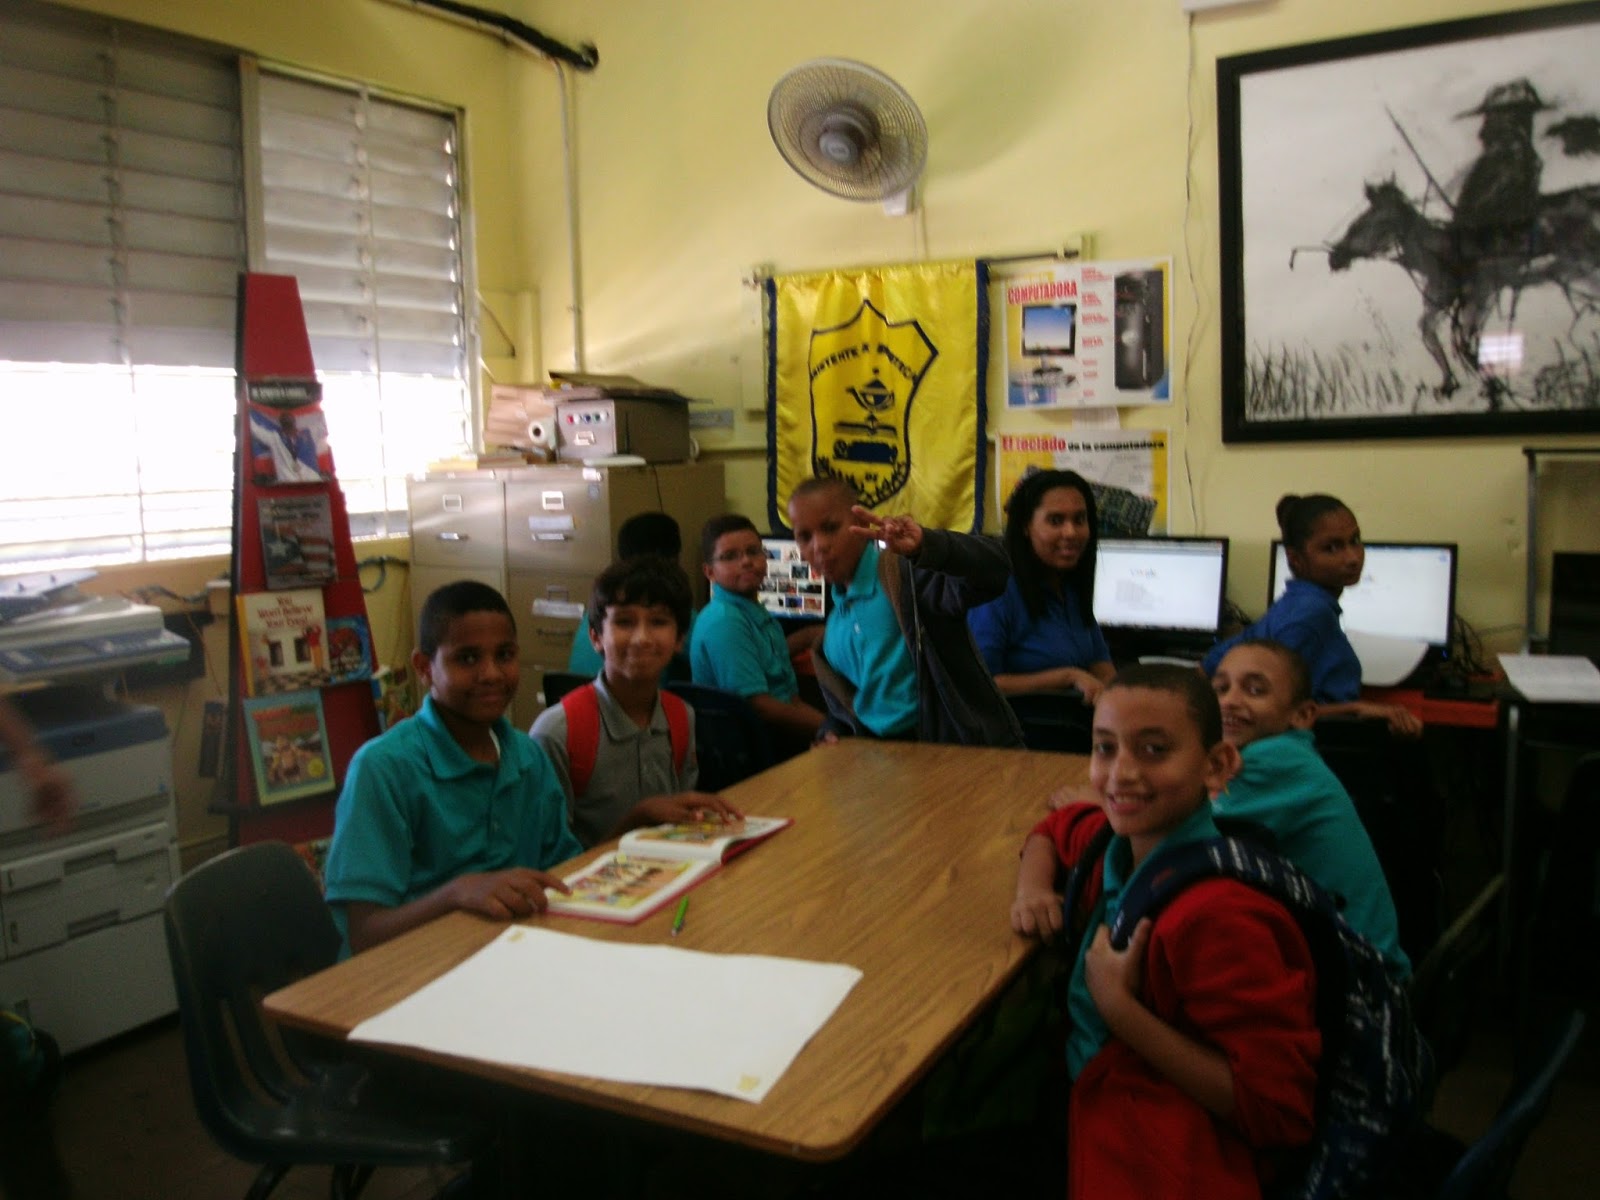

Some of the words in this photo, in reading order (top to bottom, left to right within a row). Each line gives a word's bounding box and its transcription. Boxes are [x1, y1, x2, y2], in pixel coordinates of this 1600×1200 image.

[1008, 281, 1077, 304] COMPUTADORA
[1002, 436, 1013, 451] El
[1016, 436, 1066, 451] teclado
[1094, 439, 1165, 452] computadora
